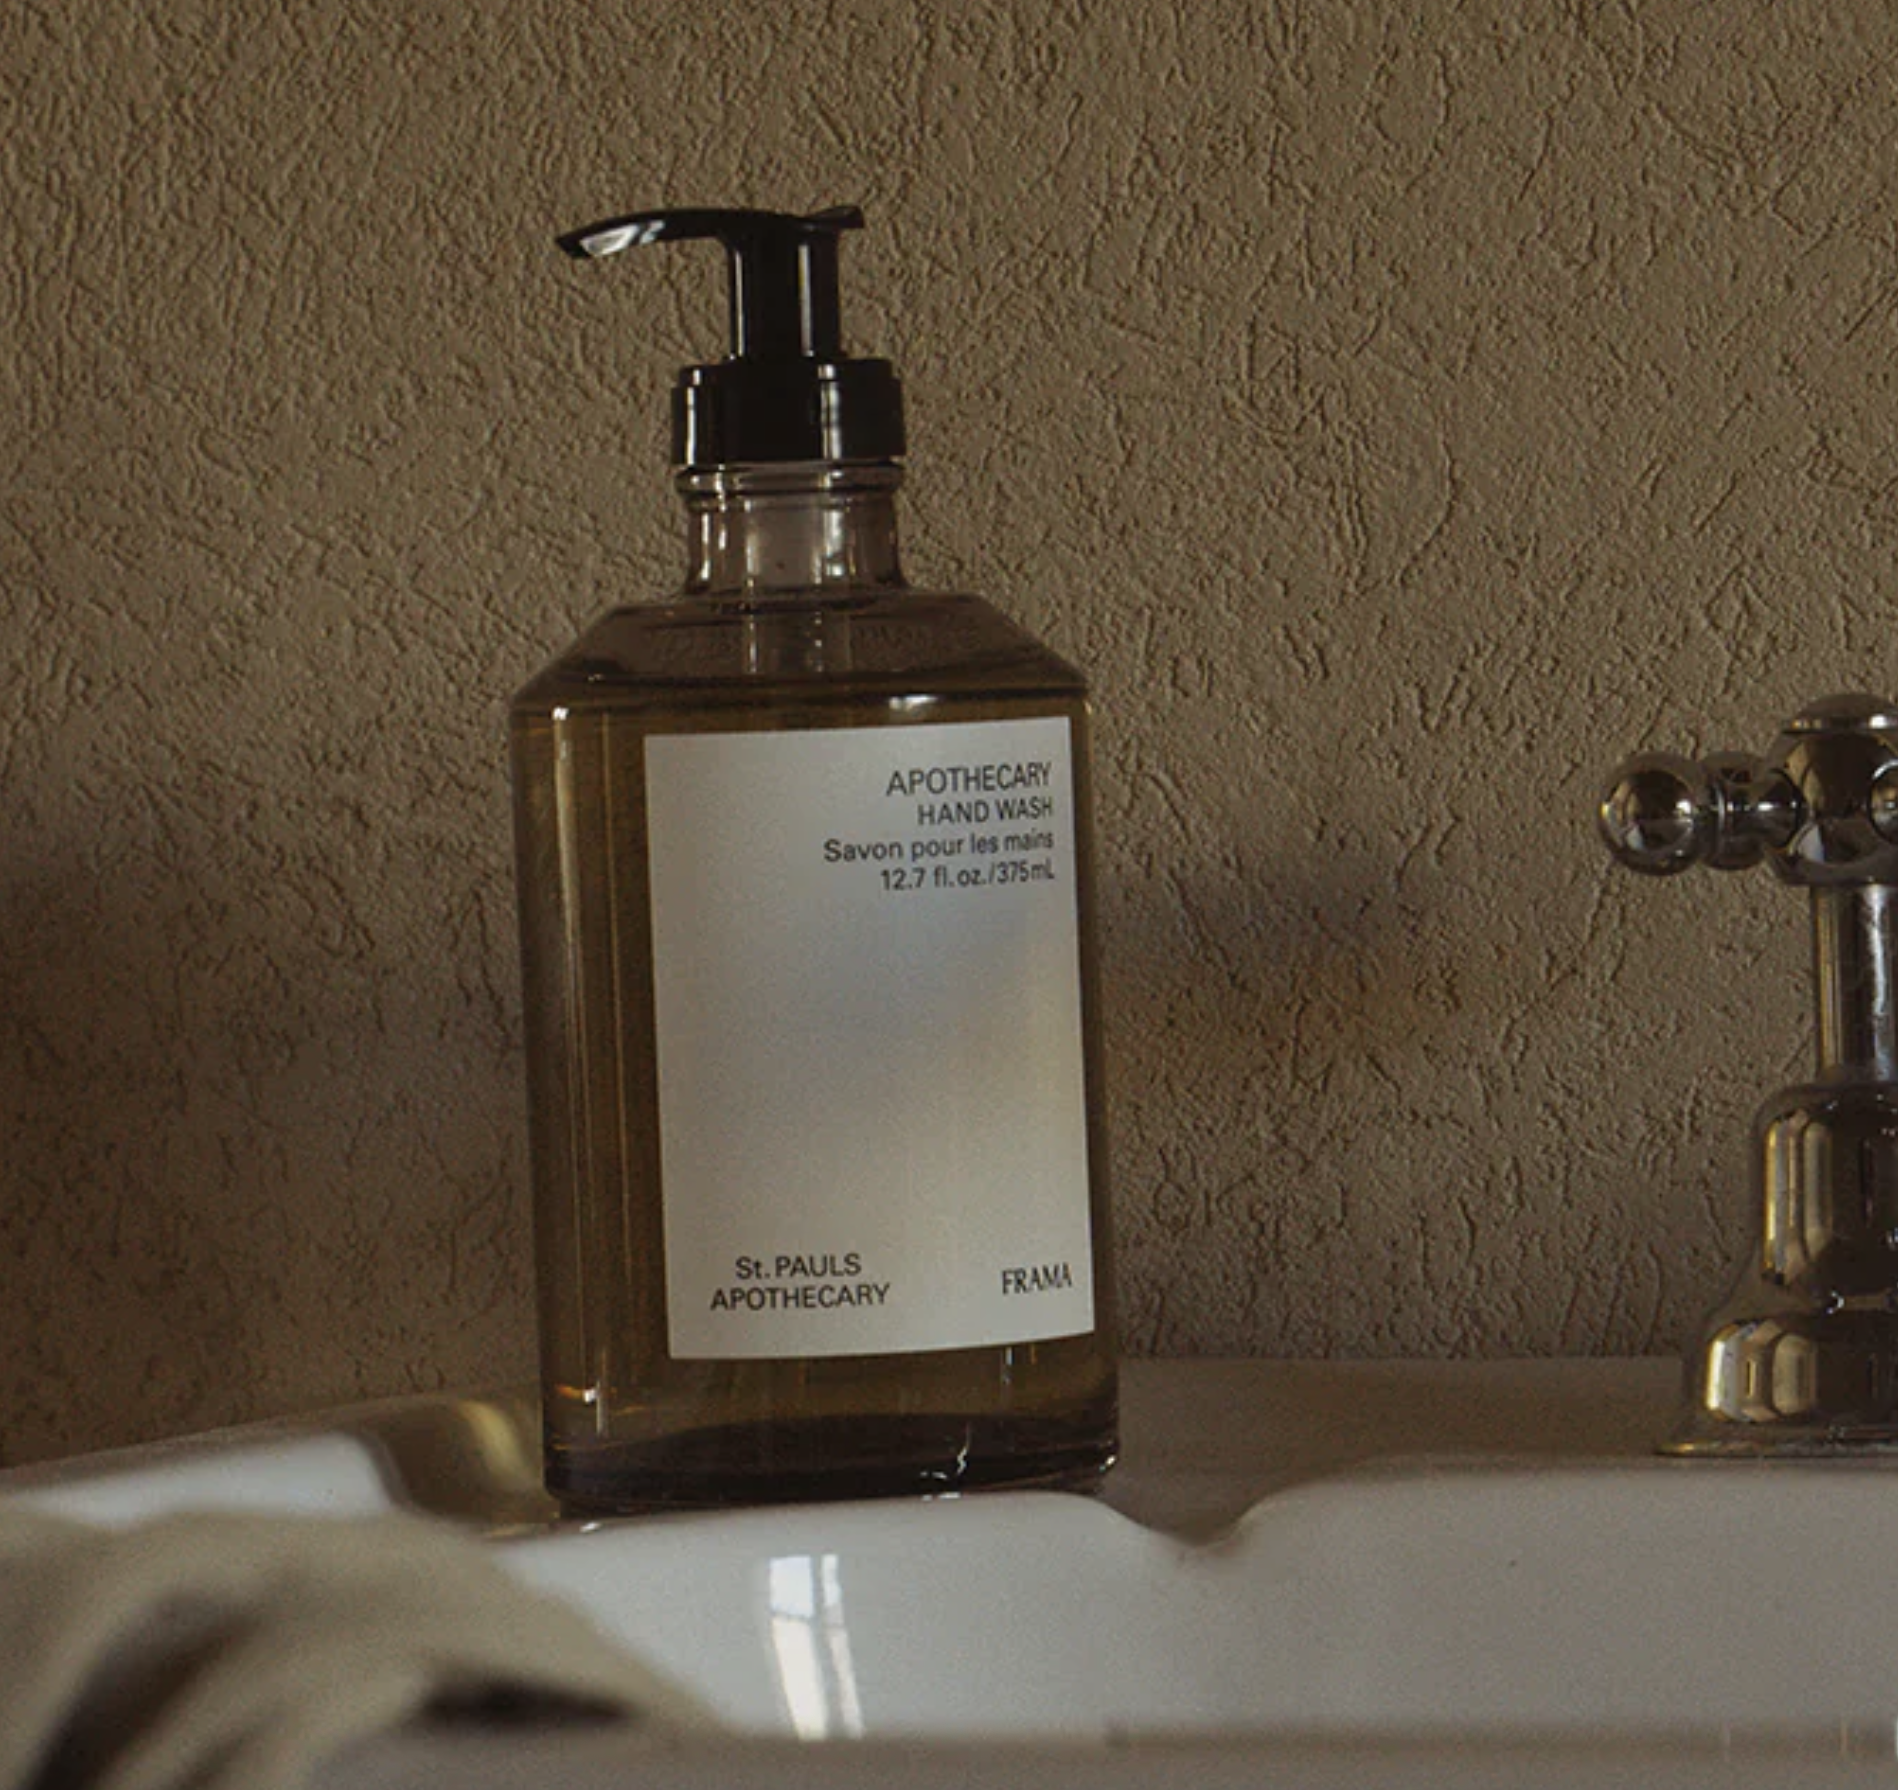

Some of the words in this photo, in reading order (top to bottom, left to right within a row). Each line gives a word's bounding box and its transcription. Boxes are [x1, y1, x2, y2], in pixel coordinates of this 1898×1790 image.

[886, 762, 1052, 797] APOTHECARY
[917, 800, 990, 826] HAND
[994, 796, 1053, 821] WASH
[823, 838, 903, 863] Savon
[911, 838, 964, 862] pour
[970, 832, 998, 854] les
[1004, 828, 1053, 851] mains
[881, 868, 926, 891] 12.7
[735, 1256, 770, 1280] St.
[775, 1253, 862, 1278] PAULS
[1001, 1262, 1073, 1296] FRAMA
[710, 1282, 891, 1311] APOTHECARY
